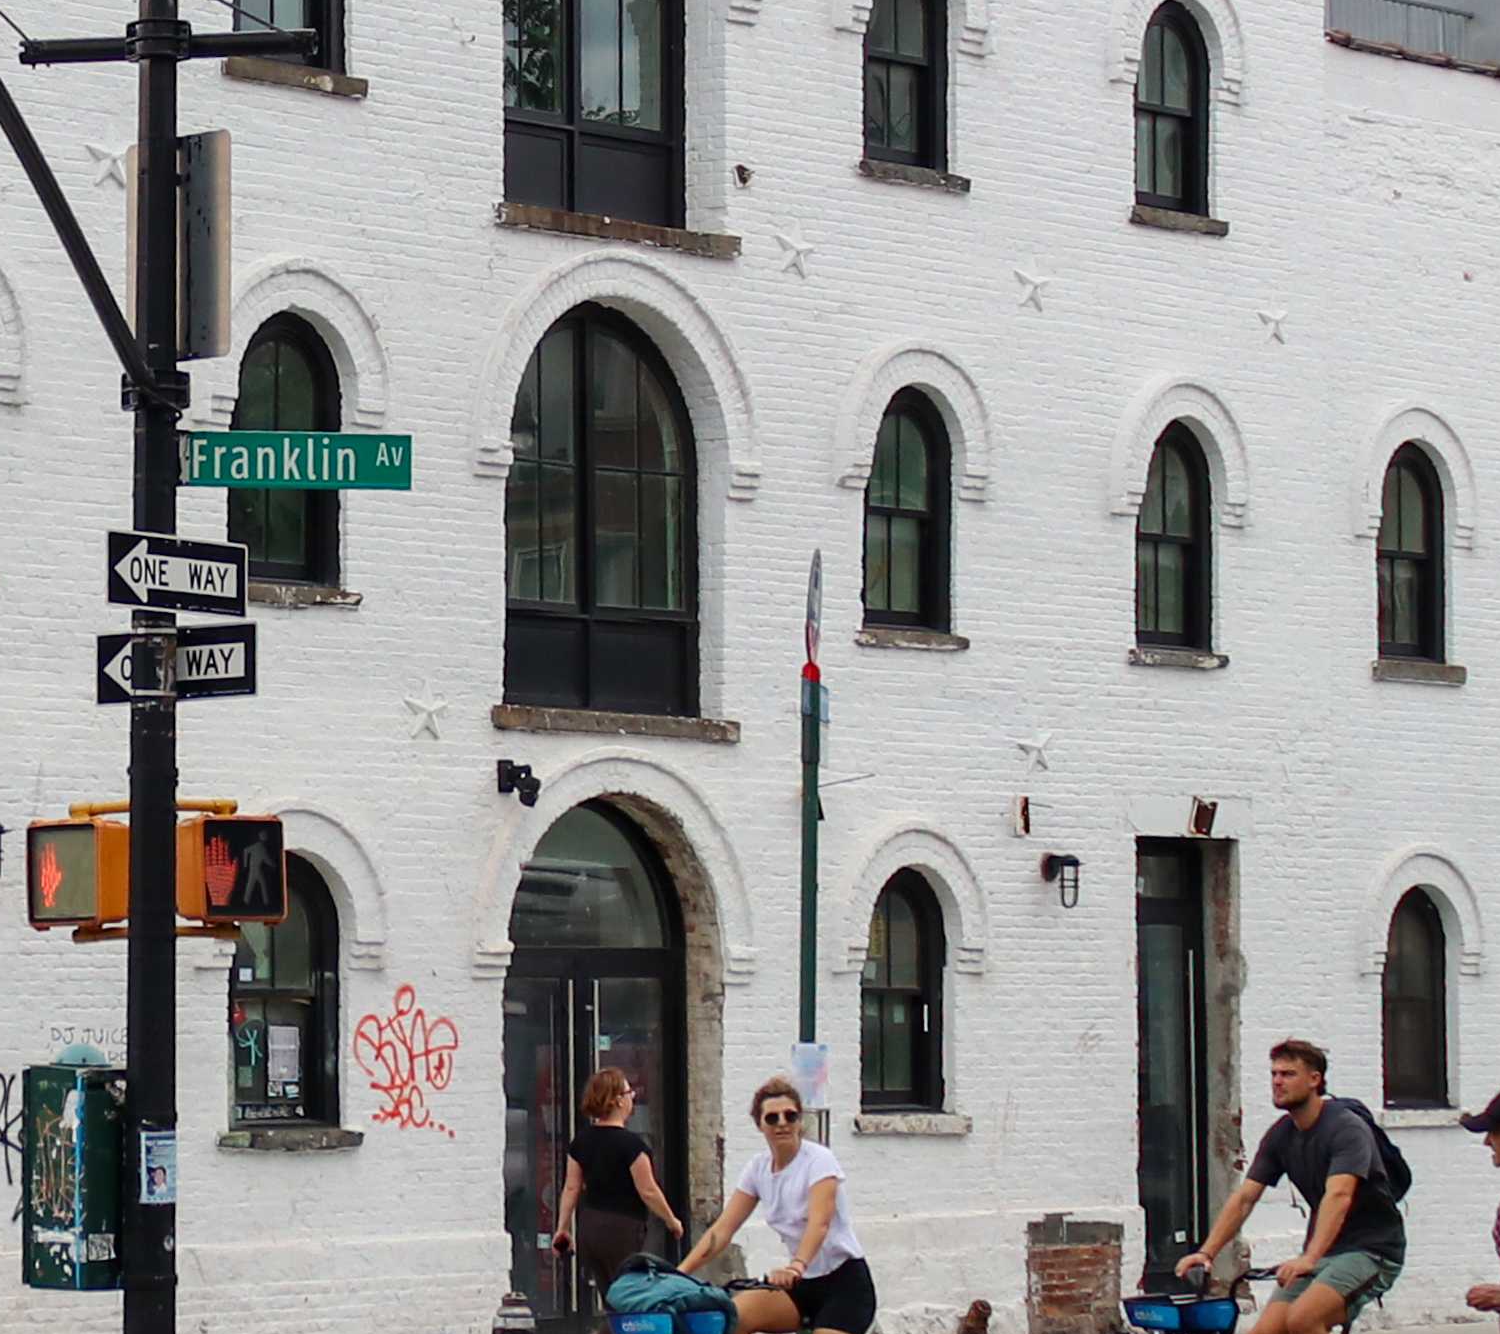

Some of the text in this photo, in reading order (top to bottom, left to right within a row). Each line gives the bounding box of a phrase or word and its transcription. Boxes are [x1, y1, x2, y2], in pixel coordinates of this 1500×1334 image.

[192, 437, 404, 481] Franklin Av
[130, 555, 229, 593] ONE WAY
[186, 648, 235, 676] WAY
